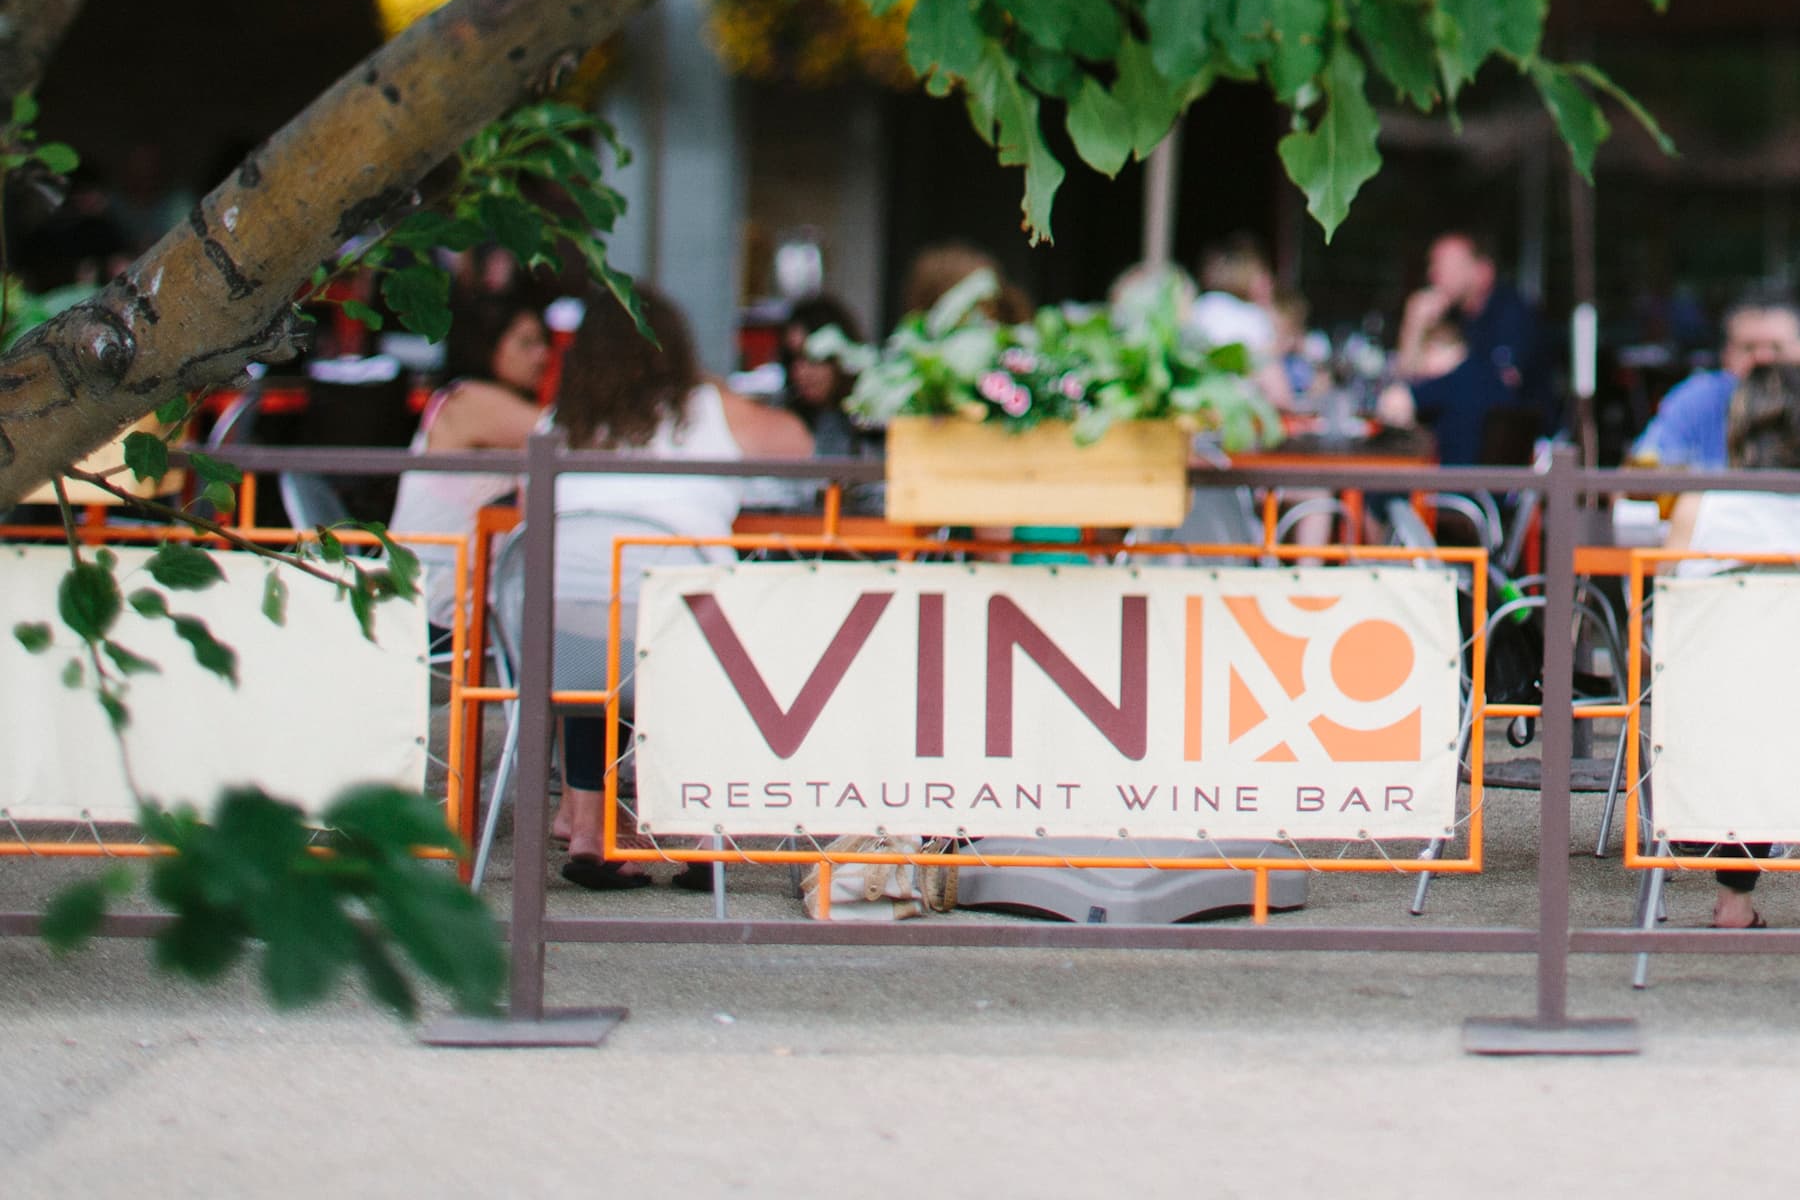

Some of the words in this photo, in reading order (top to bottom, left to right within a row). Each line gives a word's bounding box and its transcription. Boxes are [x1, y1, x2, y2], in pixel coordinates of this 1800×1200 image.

[681, 781, 1082, 810] RESTAURANT
[1115, 784, 1260, 812] WINE
[1296, 785, 1415, 813] BAR
